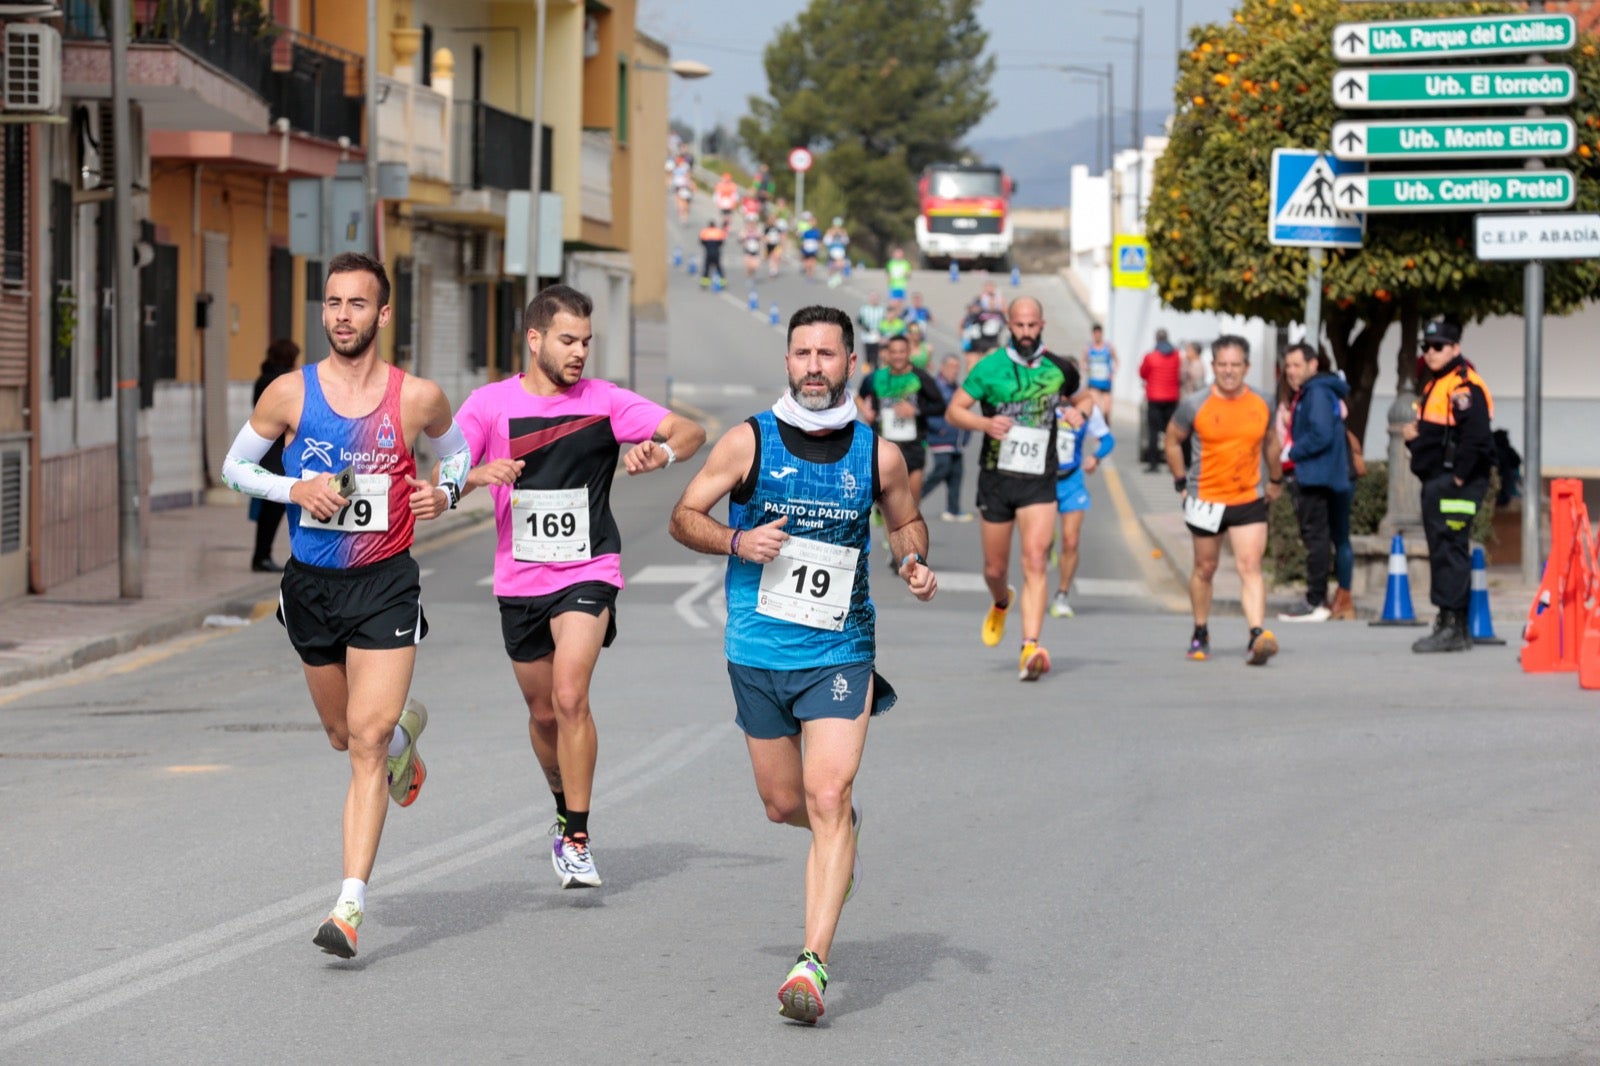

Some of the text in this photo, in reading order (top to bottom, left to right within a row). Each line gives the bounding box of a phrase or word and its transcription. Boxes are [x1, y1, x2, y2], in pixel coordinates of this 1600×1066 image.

[1372, 22, 1565, 49] Urb. Parque del Cubillas
[1425, 74, 1564, 96] Urb. El torreón
[1399, 126, 1562, 148] Urb. Monte Elvira
[1394, 178, 1563, 203] Urb. Cortijo Pretel
[1539, 226, 1599, 242] ABADÍA
[340, 447, 399, 466] lapalma
[1010, 441, 1039, 458] 705
[317, 499, 372, 527] 79
[764, 501, 859, 520] PAZITO a PAZITO
[526, 512, 576, 538] 169
[797, 518, 824, 529] Motril
[791, 564, 831, 599] 19
